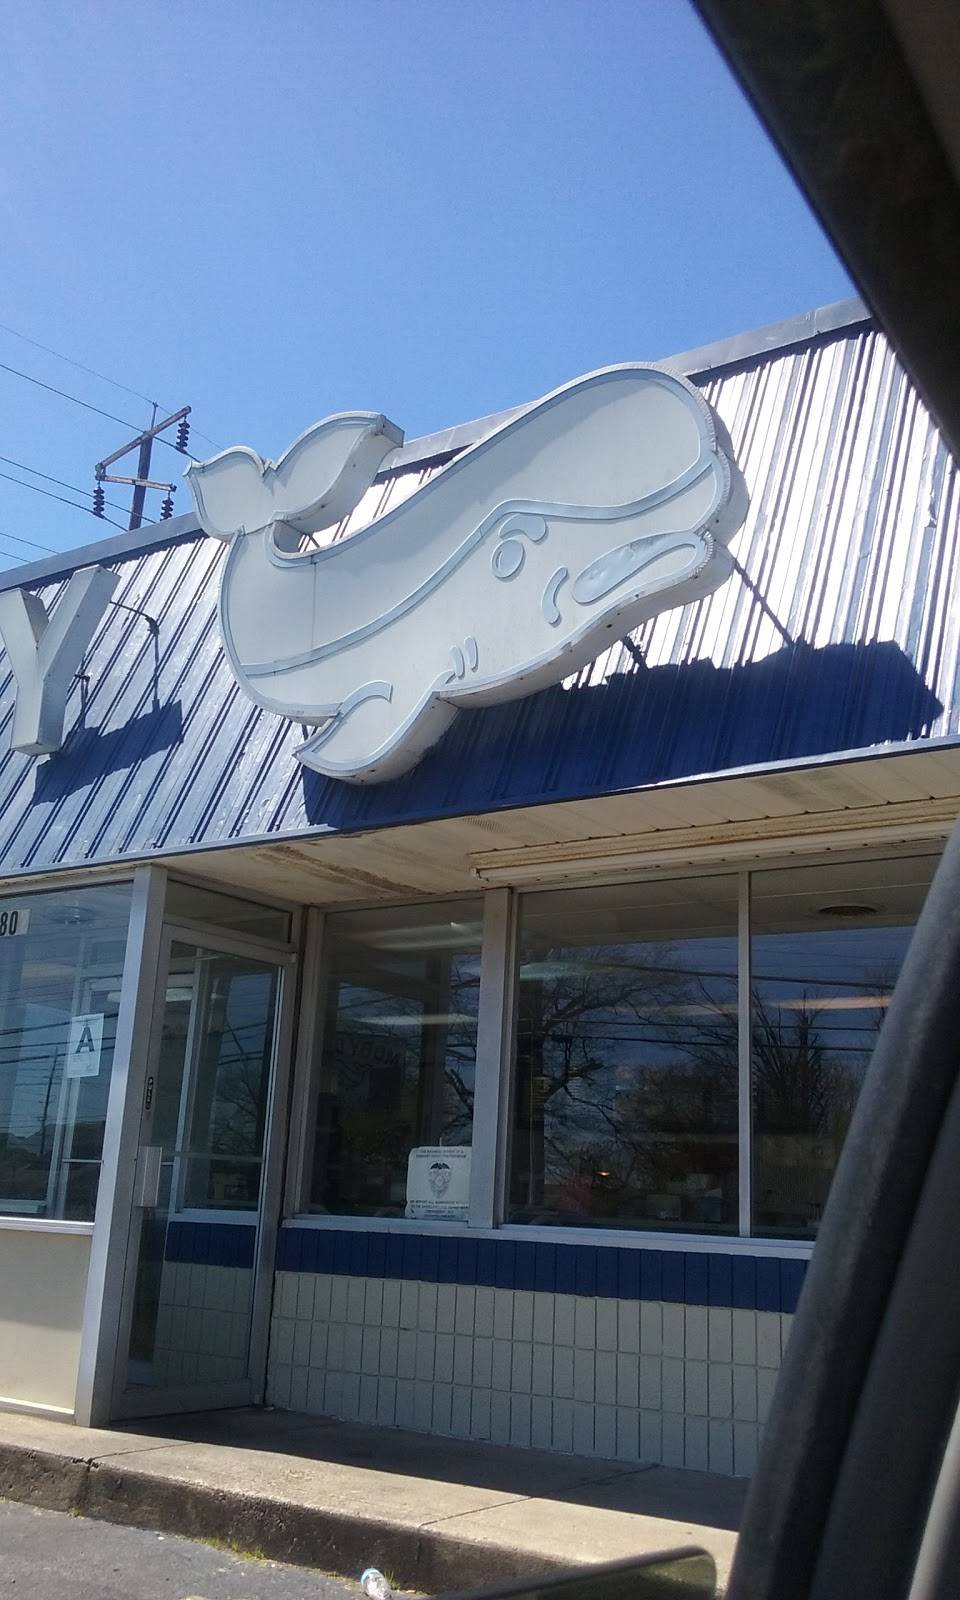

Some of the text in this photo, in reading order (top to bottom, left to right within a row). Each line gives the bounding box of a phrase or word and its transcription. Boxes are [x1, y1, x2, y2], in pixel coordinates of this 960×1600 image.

[0, 564, 119, 756] Y
[0, 911, 18, 936] 80
[76, 1026, 95, 1054] A
